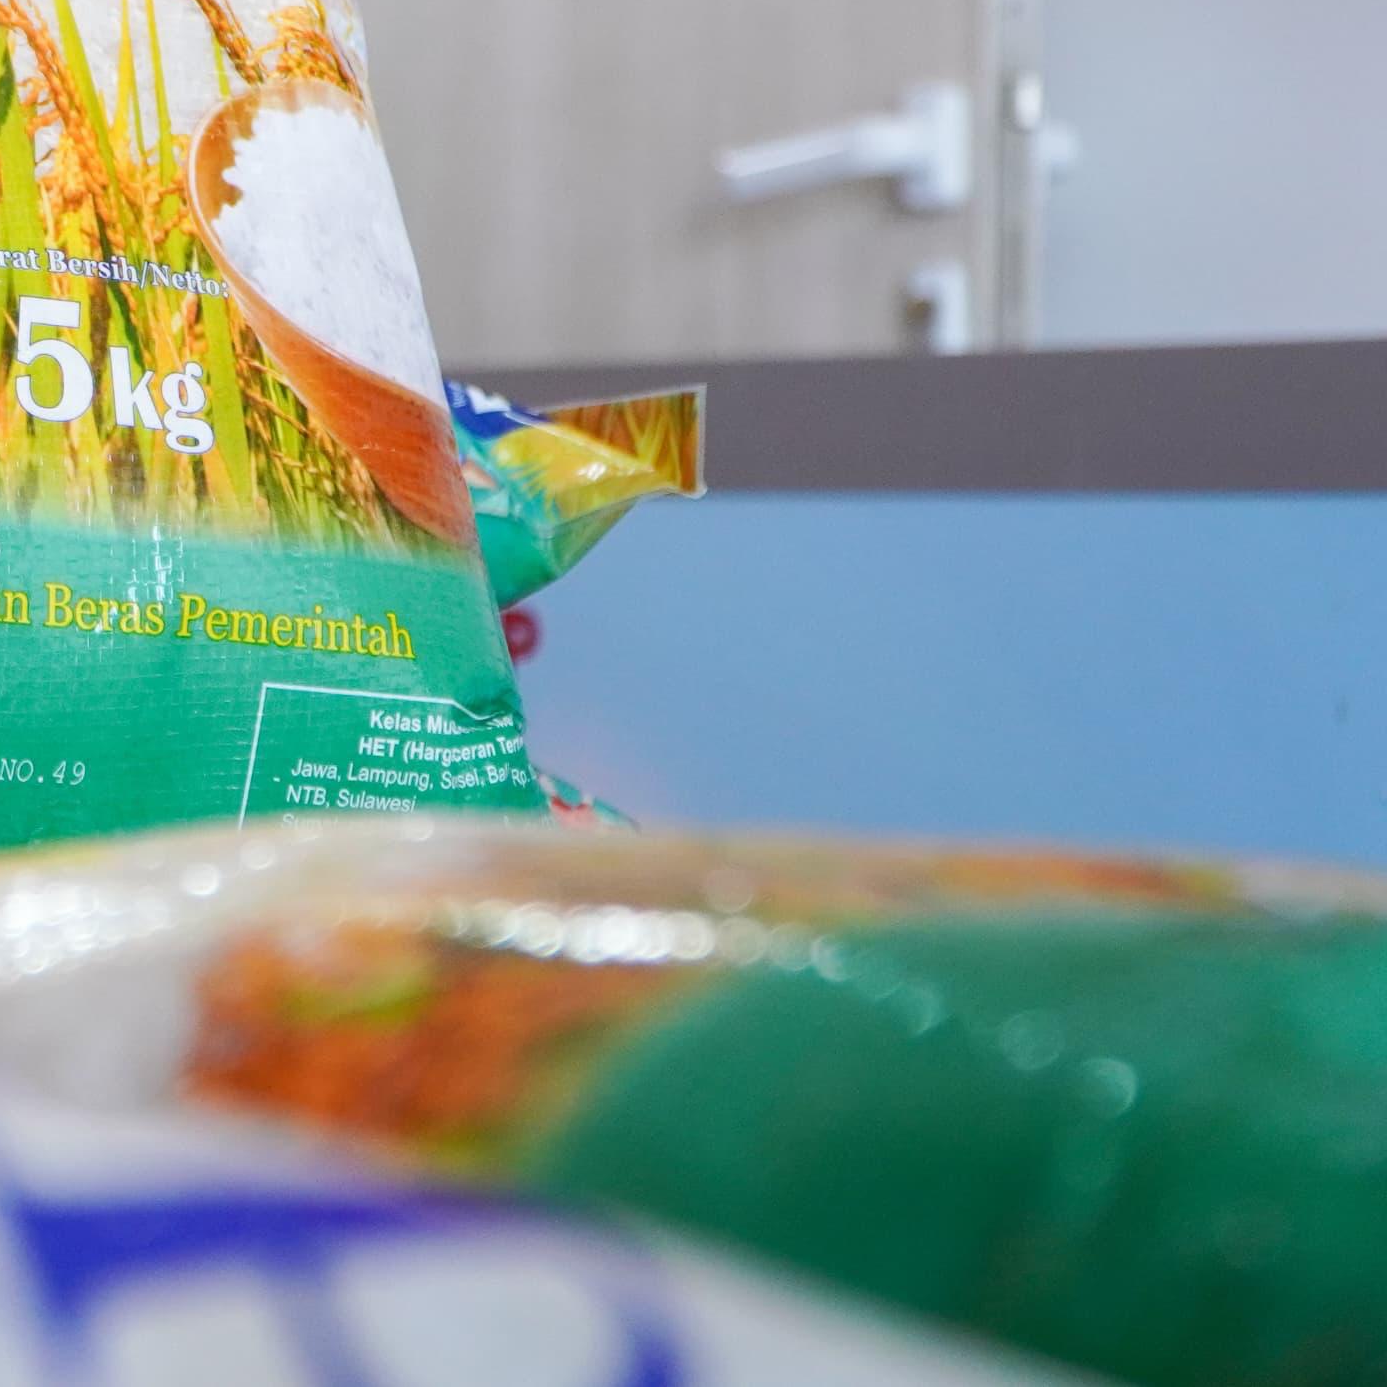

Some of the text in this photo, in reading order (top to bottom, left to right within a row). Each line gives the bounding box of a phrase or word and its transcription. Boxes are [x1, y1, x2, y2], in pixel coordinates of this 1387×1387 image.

[46, 248, 229, 298] Bersih/Netto:
[44, 581, 165, 637] Beras
[177, 592, 416, 661] Pemerintah
[370, 710, 422, 733] Kelas
[359, 735, 399, 758] HET
[291, 758, 341, 782] Jawa,
[347, 763, 434, 791] Lampung,
[287, 784, 417, 813] NTB, Sulawesi
